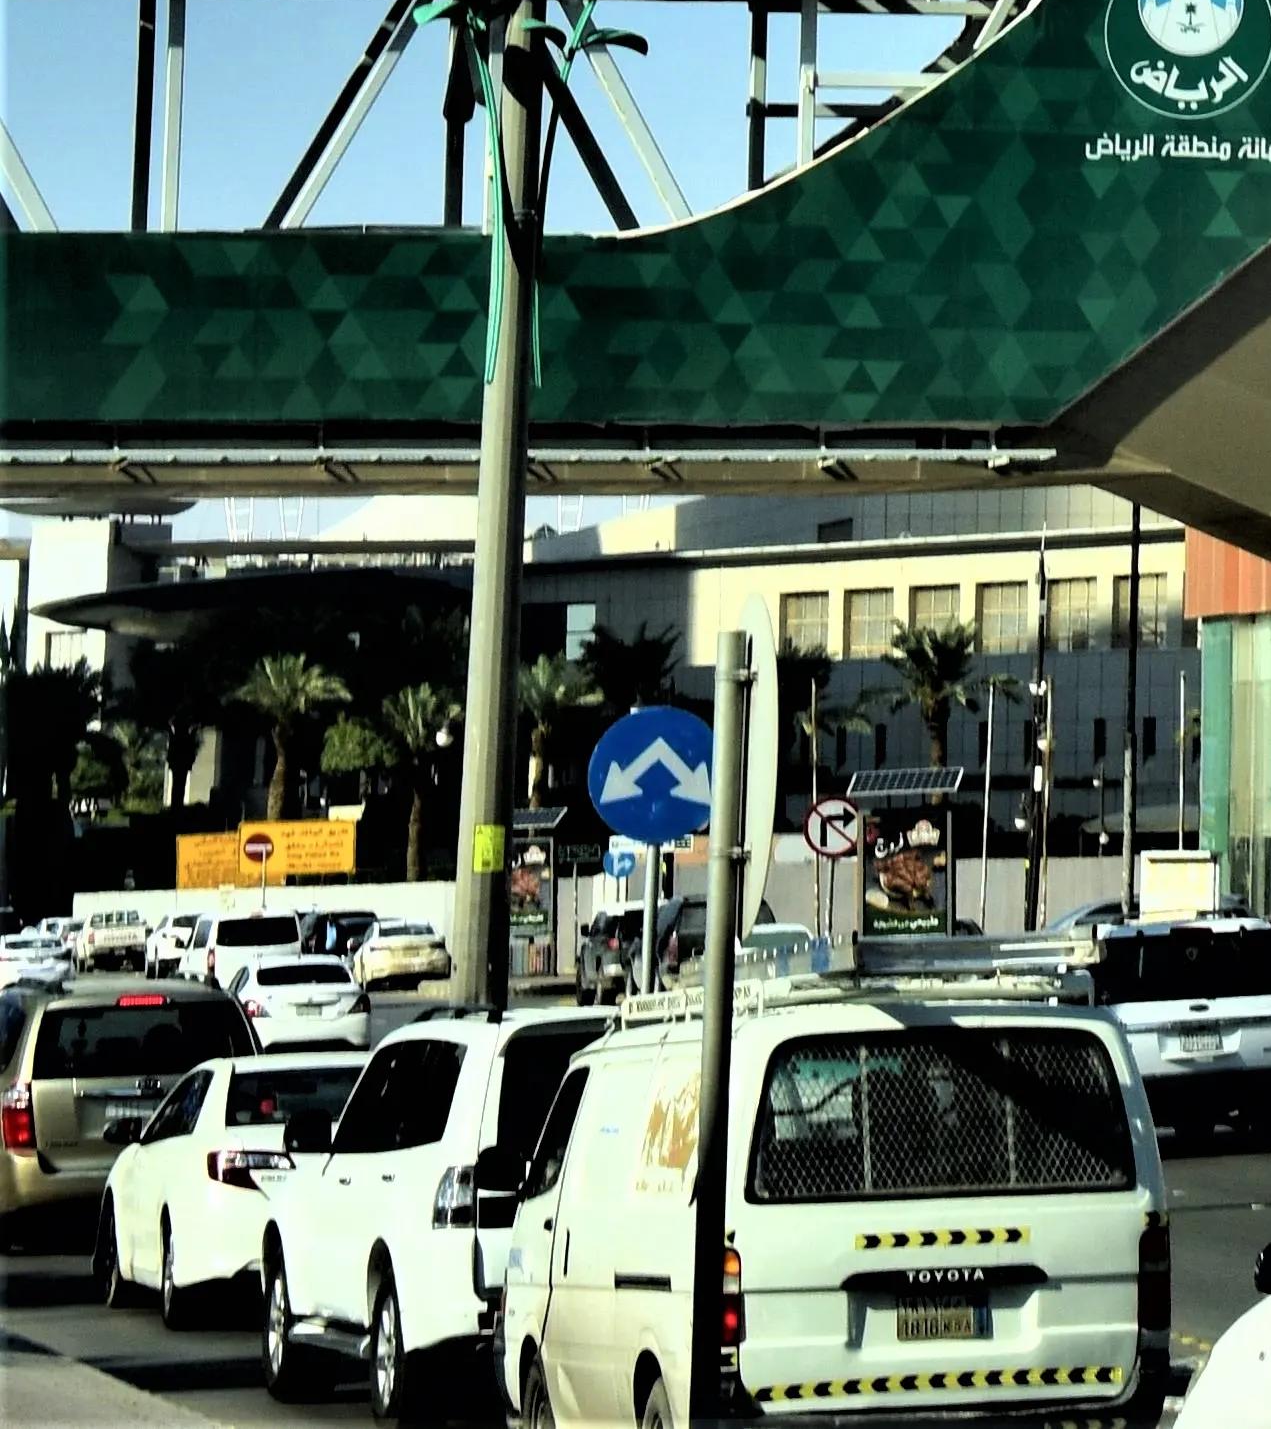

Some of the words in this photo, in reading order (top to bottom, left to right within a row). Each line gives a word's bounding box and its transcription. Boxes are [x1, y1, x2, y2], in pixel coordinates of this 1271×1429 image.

[1130, 55, 1249, 111] الرياض
[1084, 131, 1155, 162] الرياض
[1160, 133, 1232, 161] منطقة
[906, 1267, 985, 1284] TOYOTA
